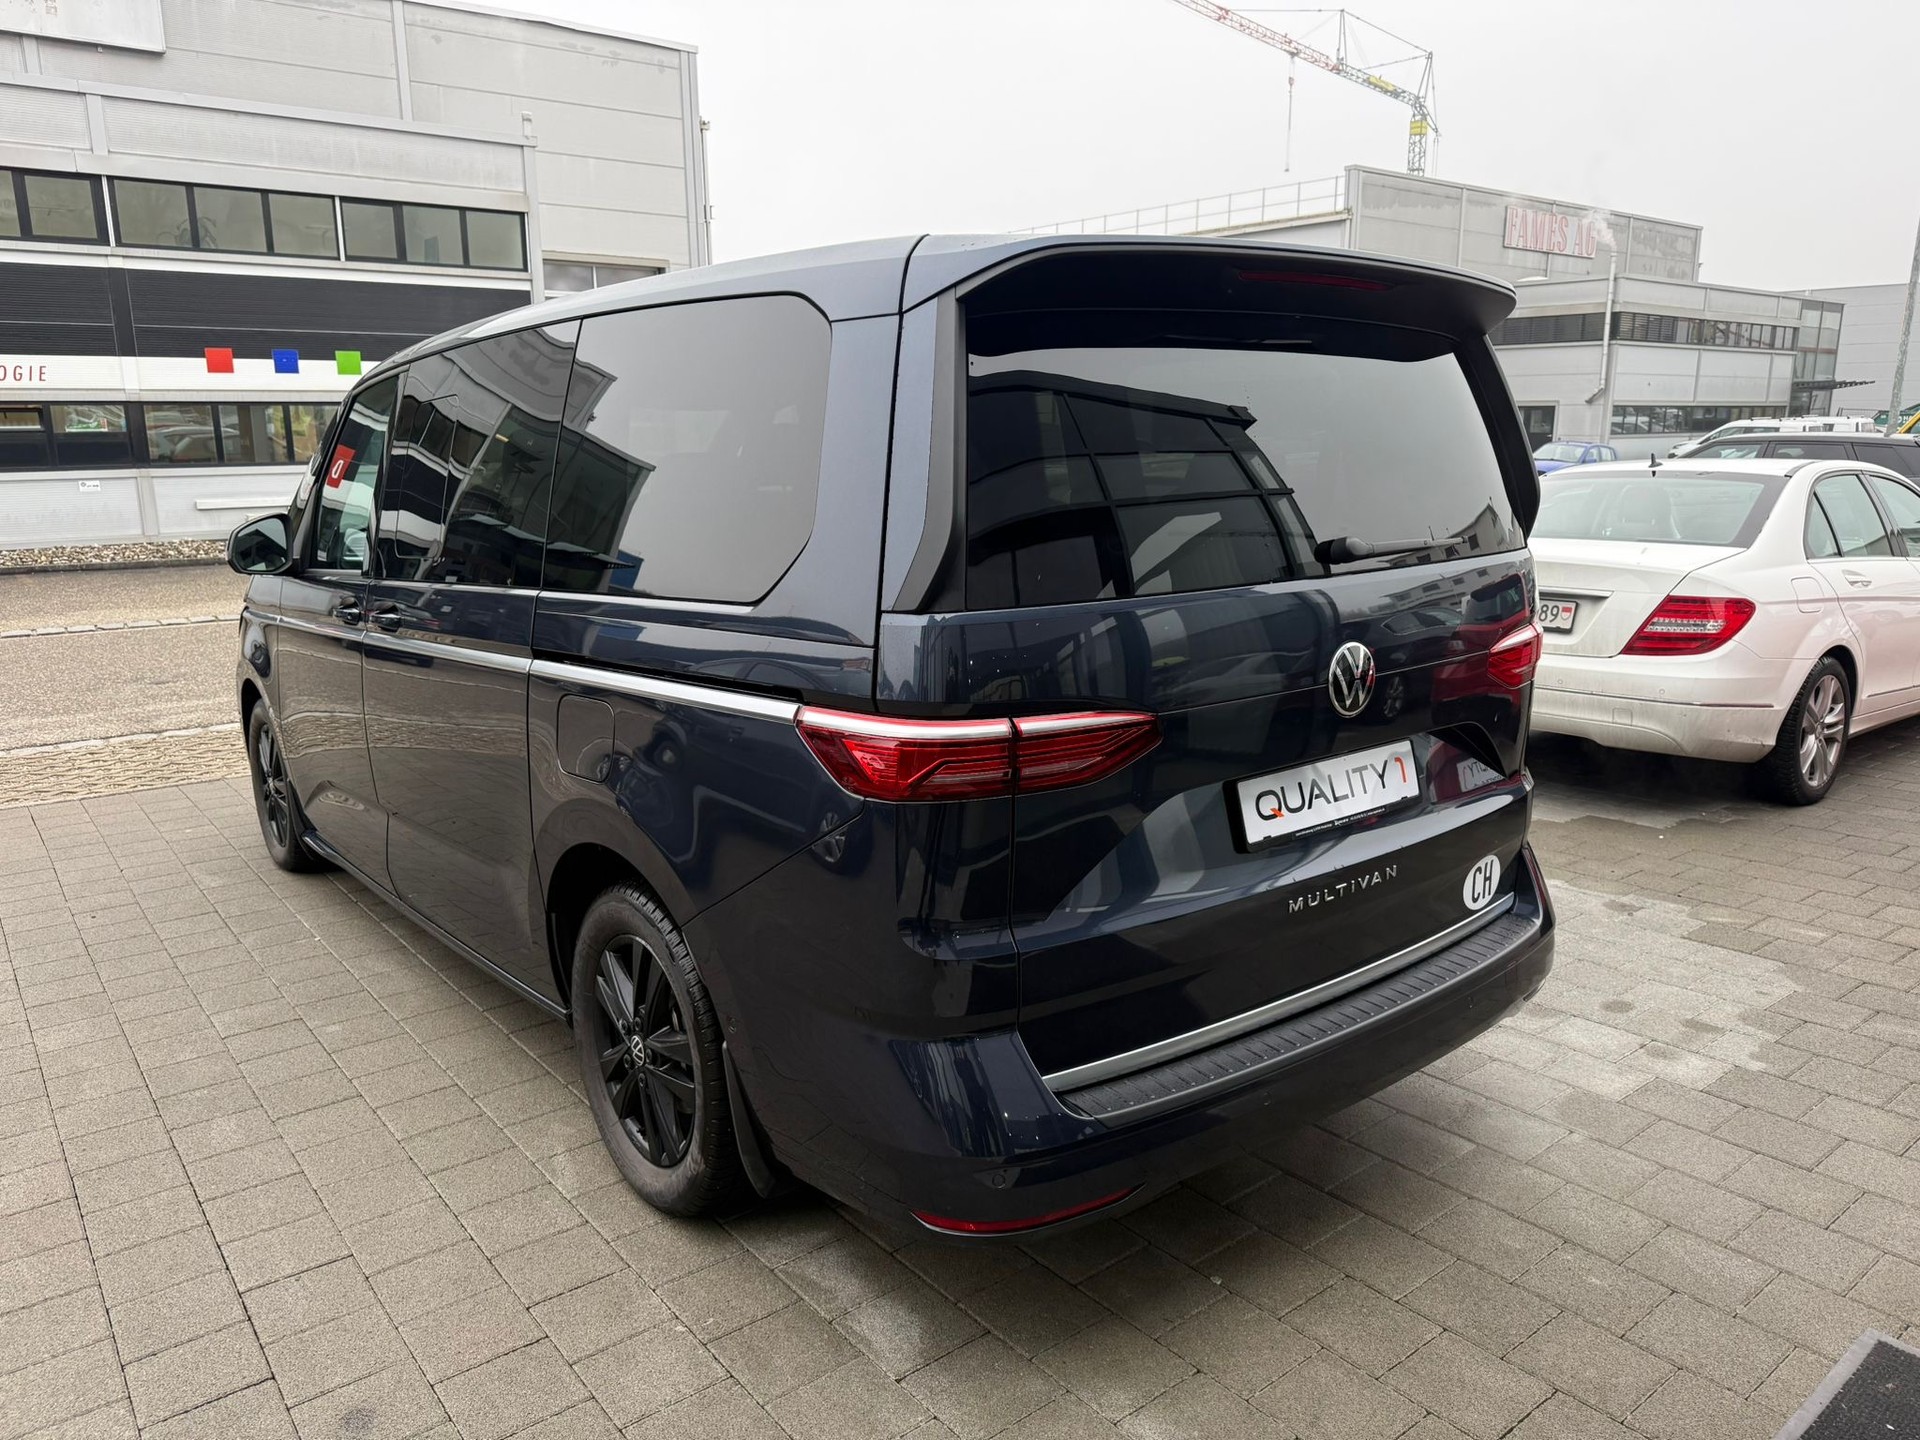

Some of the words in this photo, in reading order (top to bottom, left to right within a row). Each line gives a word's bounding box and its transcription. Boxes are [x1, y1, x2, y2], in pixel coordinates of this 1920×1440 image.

[0, 364, 47, 382] OGIE
[1538, 603, 1560, 623] 89
[1288, 864, 1398, 914] MULTIVAN
[1471, 859, 1494, 904] CH
